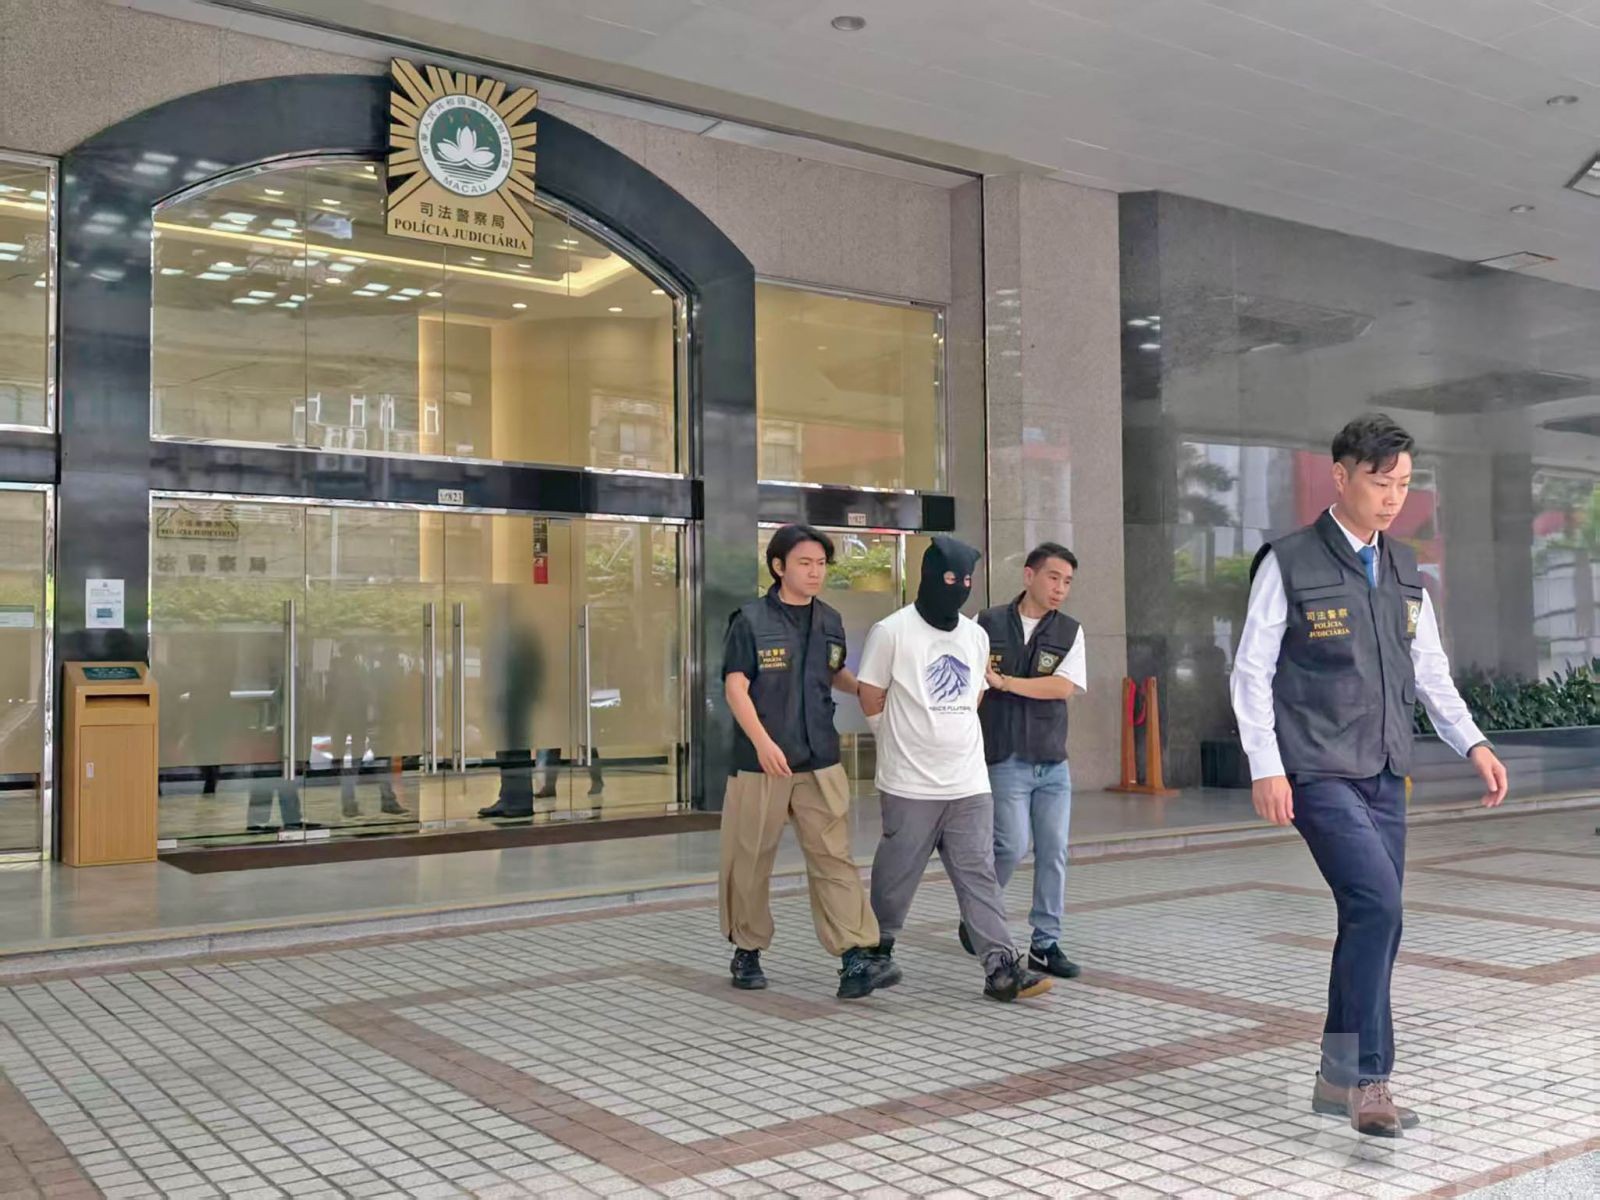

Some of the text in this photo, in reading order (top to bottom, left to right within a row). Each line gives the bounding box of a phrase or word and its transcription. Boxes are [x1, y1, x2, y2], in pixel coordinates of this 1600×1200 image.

[442, 176, 487, 193] MACAU
[420, 201, 505, 229] 司法警察局
[394, 218, 527, 250] POLÍCIA JUDICIÁRIA
[1306, 608, 1348, 621] 司法警察
[1314, 620, 1343, 630] POLÍCIA
